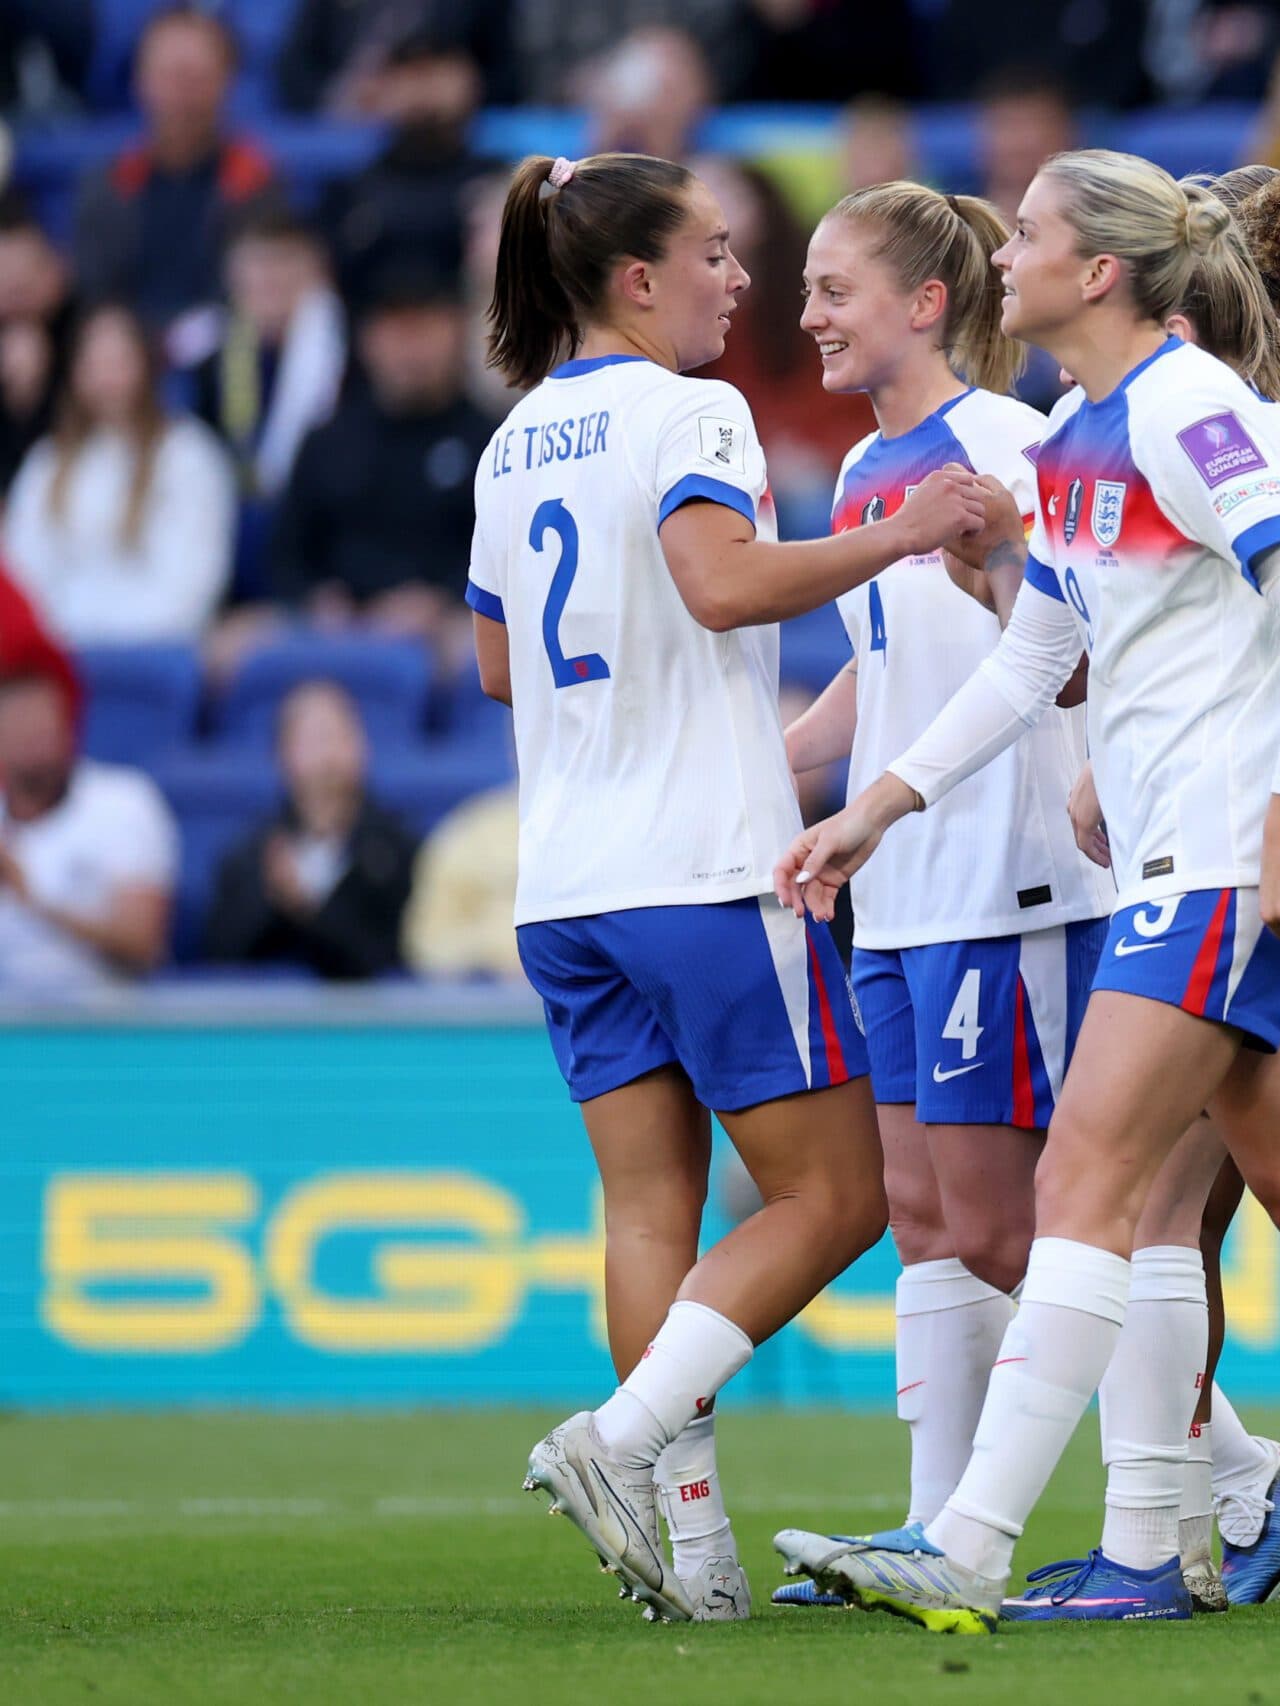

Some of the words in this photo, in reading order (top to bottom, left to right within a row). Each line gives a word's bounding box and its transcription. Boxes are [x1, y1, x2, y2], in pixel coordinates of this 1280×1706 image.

[493, 429, 515, 479] LE
[523, 410, 610, 470] TISSIER
[528, 497, 611, 689] 2
[941, 968, 985, 1060] 4
[679, 1480, 710, 1502] ENG
